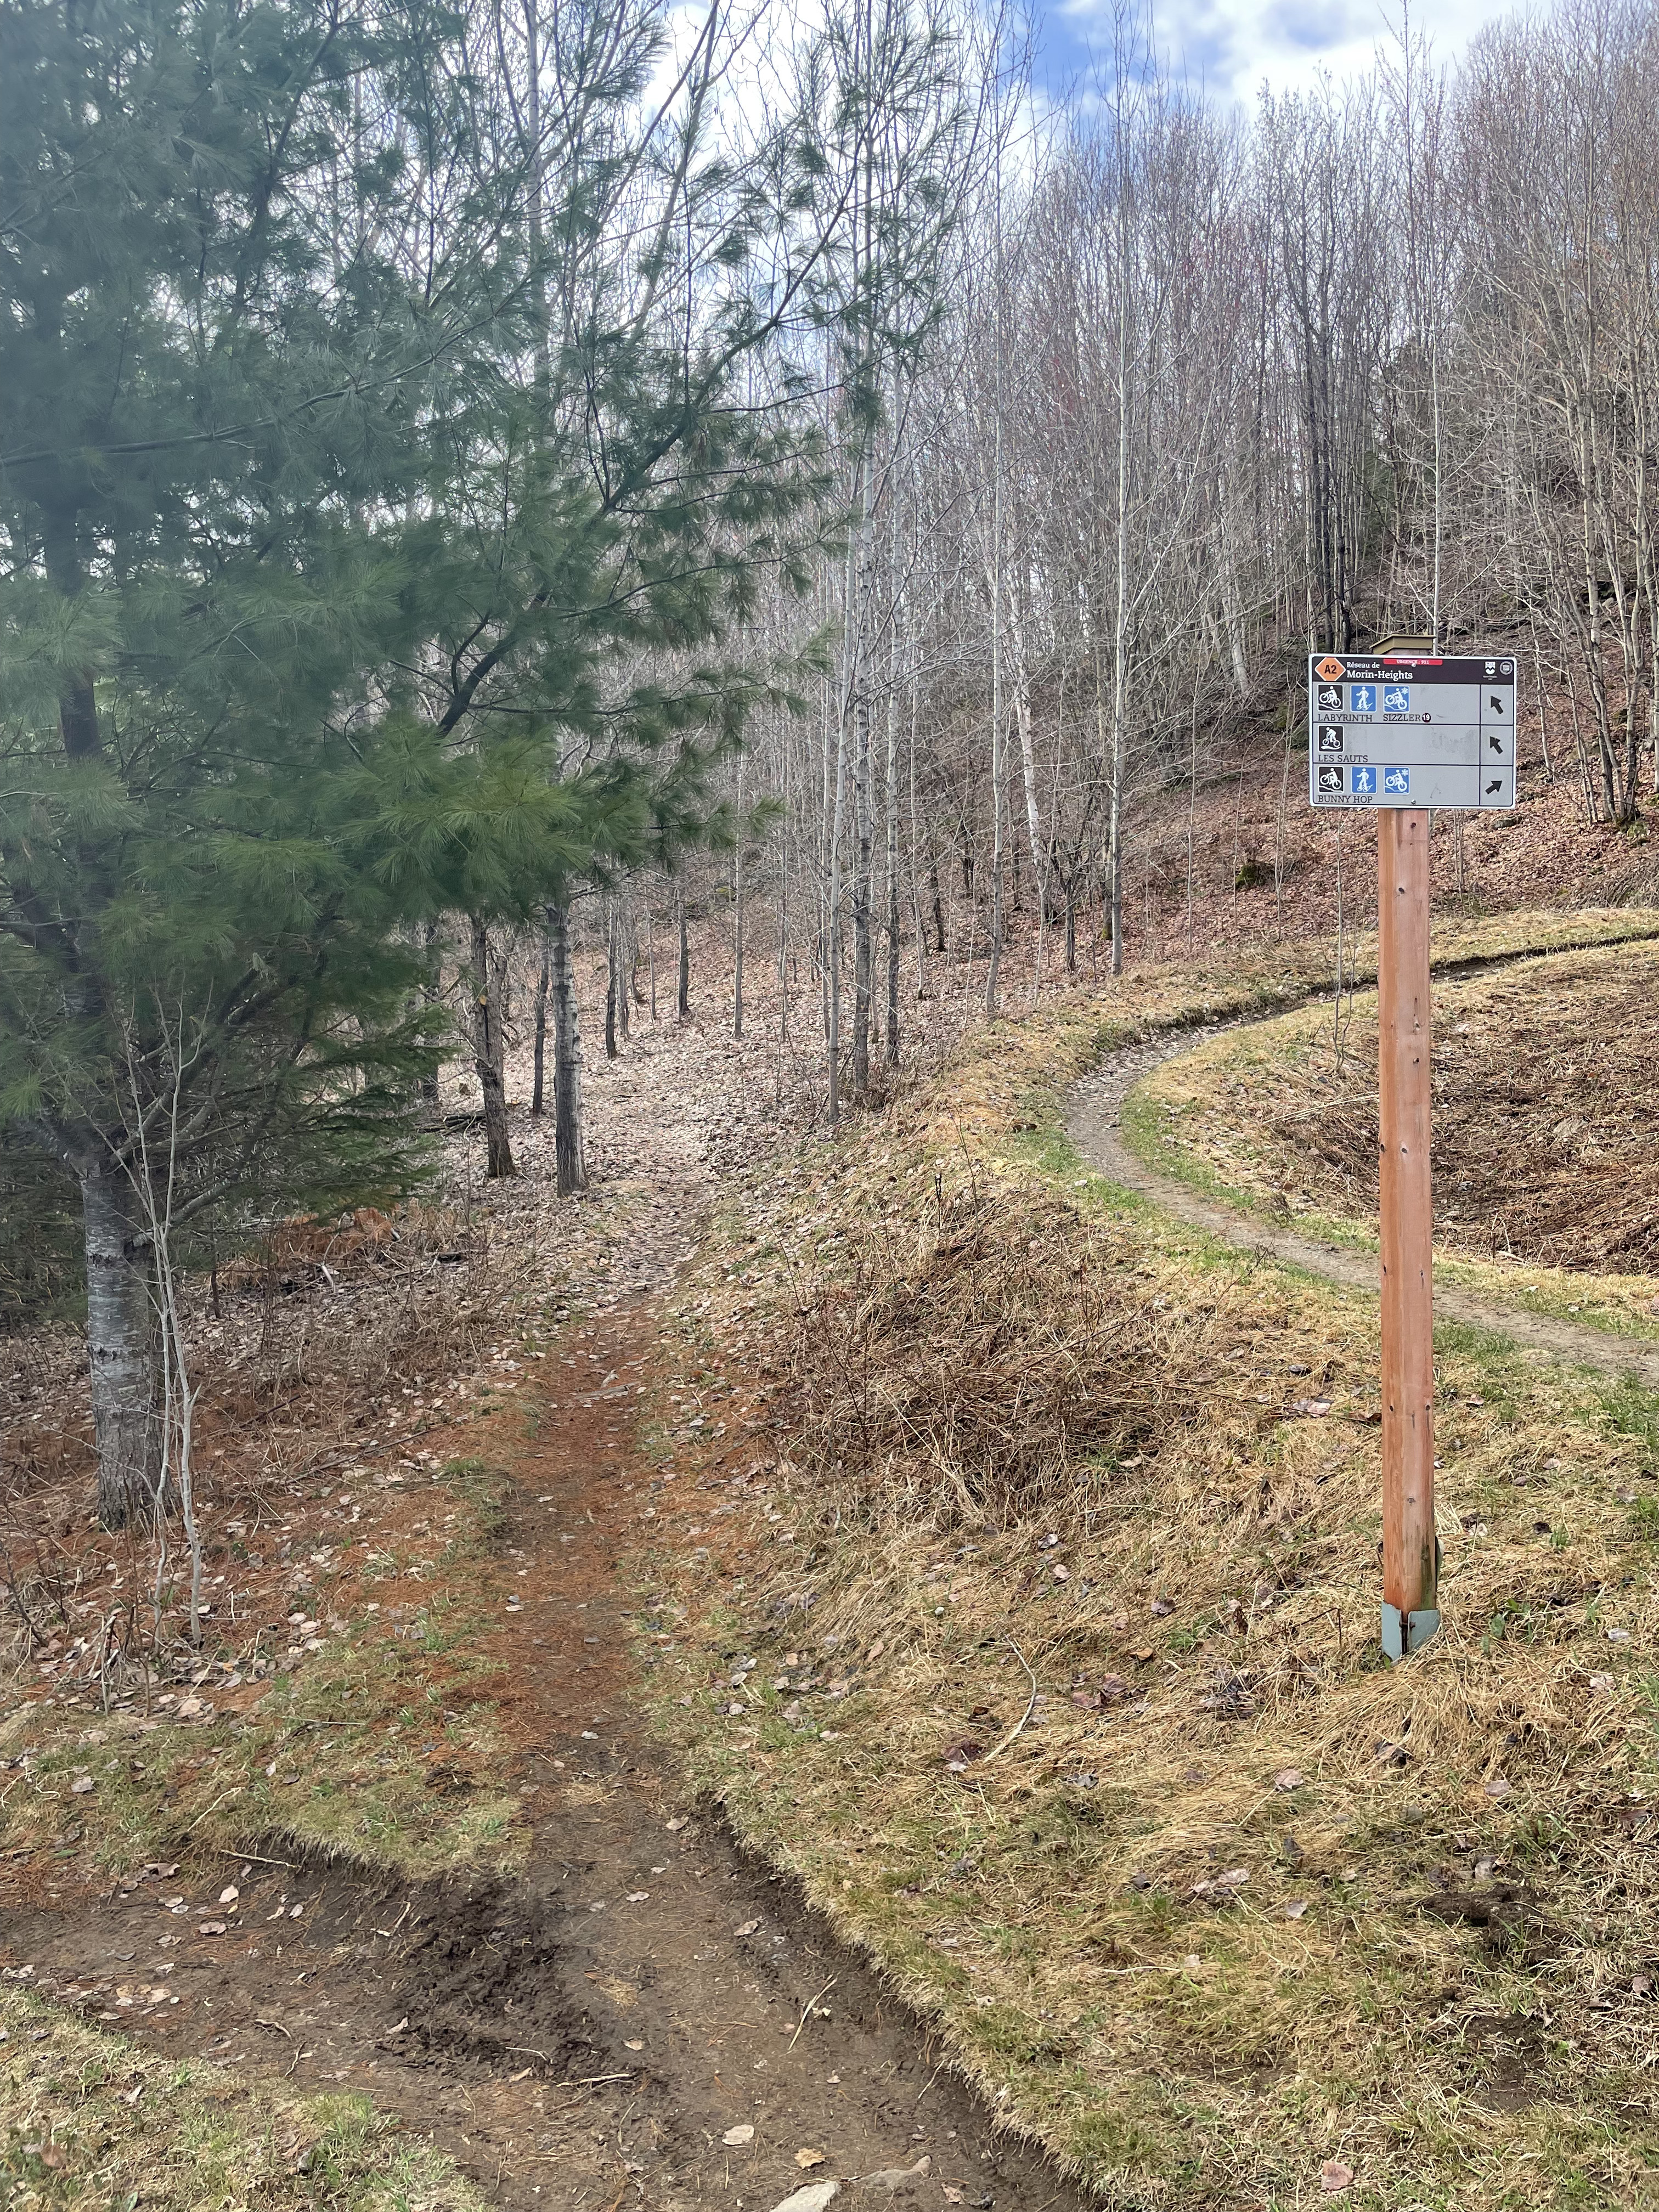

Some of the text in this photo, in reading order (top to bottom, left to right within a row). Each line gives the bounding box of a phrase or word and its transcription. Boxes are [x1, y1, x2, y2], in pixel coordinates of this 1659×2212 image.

[1324, 664, 1337, 674] A2
[1347, 670, 1413, 680] Morin-Heights
[1318, 714, 1373, 722] LABYRINTH
